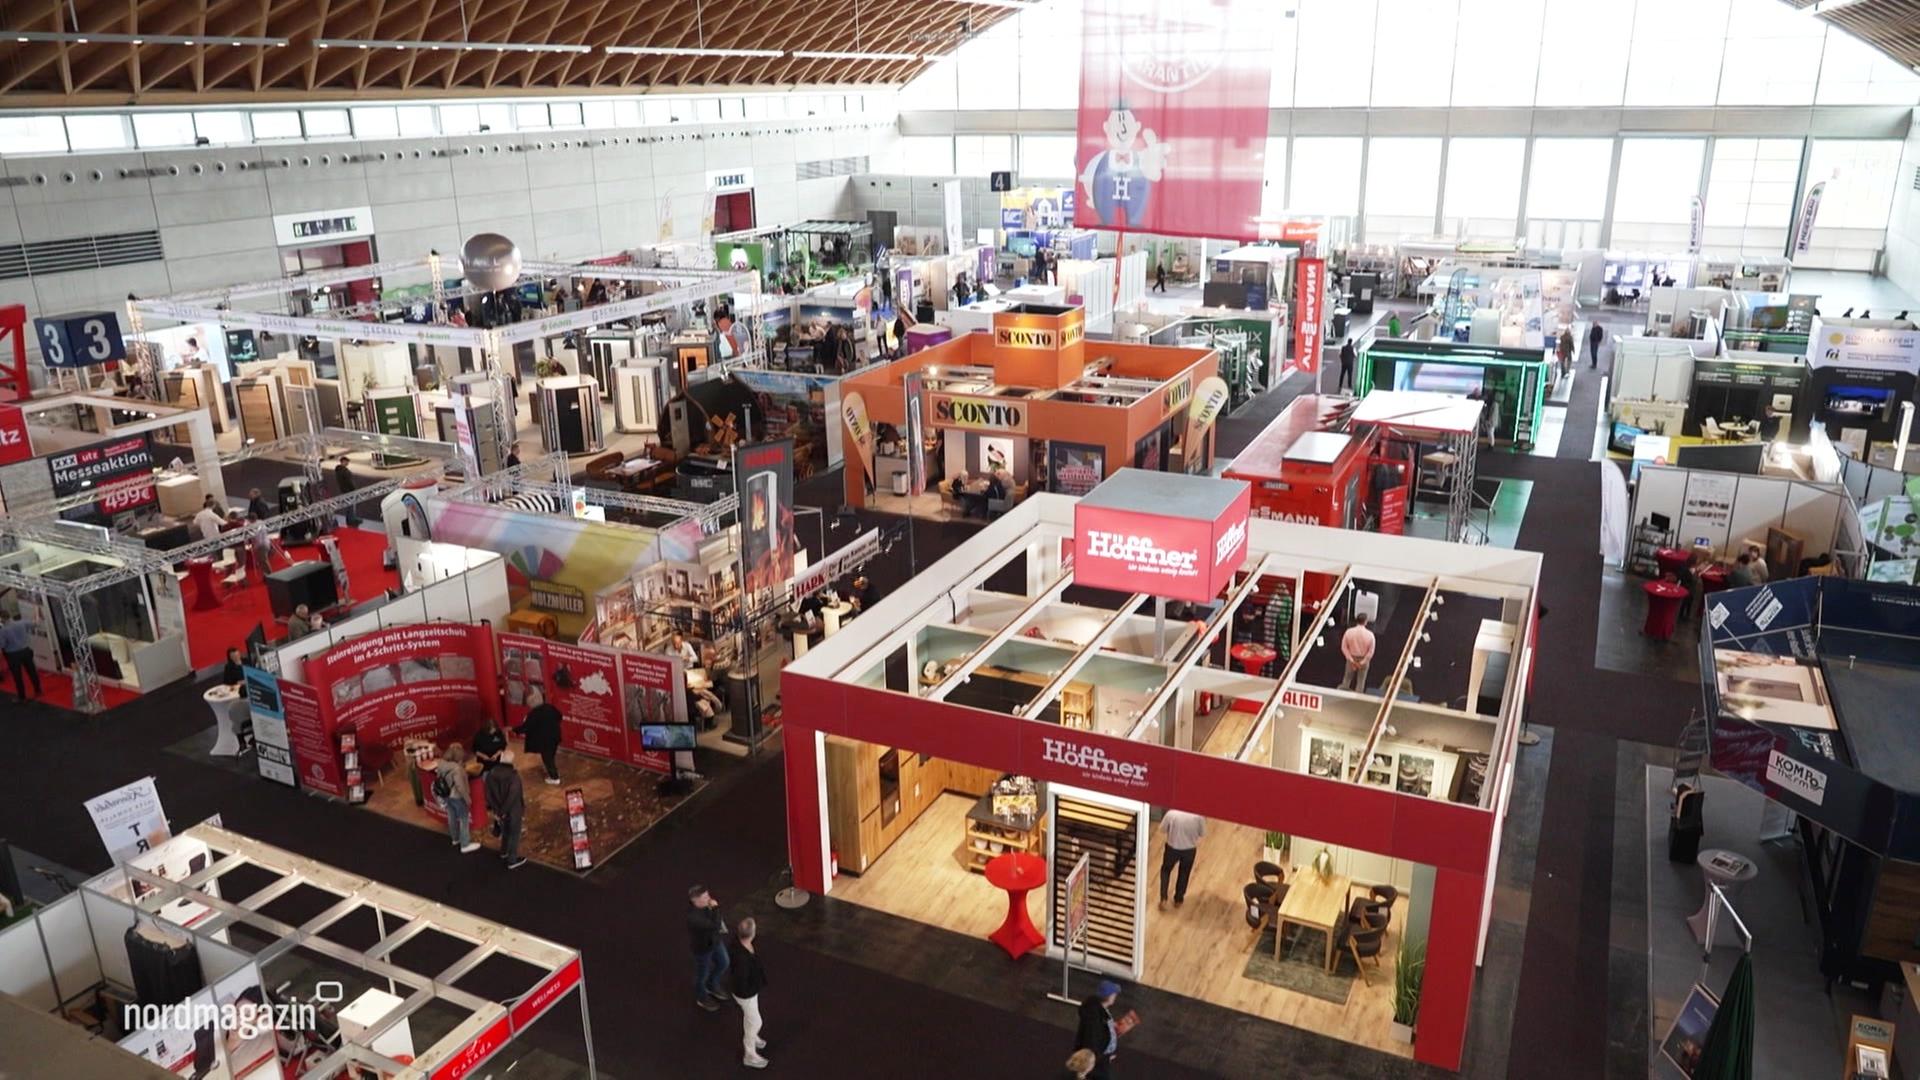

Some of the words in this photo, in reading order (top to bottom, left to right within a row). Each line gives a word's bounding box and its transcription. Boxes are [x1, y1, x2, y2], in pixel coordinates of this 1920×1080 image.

[995, 174, 1005, 191] 4
[1112, 176, 1131, 200] H
[43, 323, 65, 365] 3
[82, 319, 112, 362] 3
[999, 329, 1052, 348] SCONTO
[1060, 321, 1084, 347] SCONTO
[1164, 376, 1192, 411] SCONTO
[935, 399, 1021, 428] SCONTO
[1194, 388, 1224, 432] SCONTO
[0, 429, 22, 447] tz
[53, 451, 149, 486] Messeaktion
[1250, 506, 1320, 526] ESSMANN
[1087, 530, 1198, 570] Höffner
[796, 573, 826, 599] HARK
[531, 590, 584, 614] HOLZMÜLLER
[326, 637, 384, 666] Steinreinigung
[384, 632, 401, 643] mit
[402, 627, 467, 640] Langzeitschutz
[354, 654, 365, 664] im
[365, 639, 441, 659] 4-Schritt-System
[1282, 691, 1319, 709] ALNO
[1043, 737, 1148, 780] Höffner
[1775, 755, 1819, 787] KOMPO
[532, 980, 561, 1008] WELLNESS
